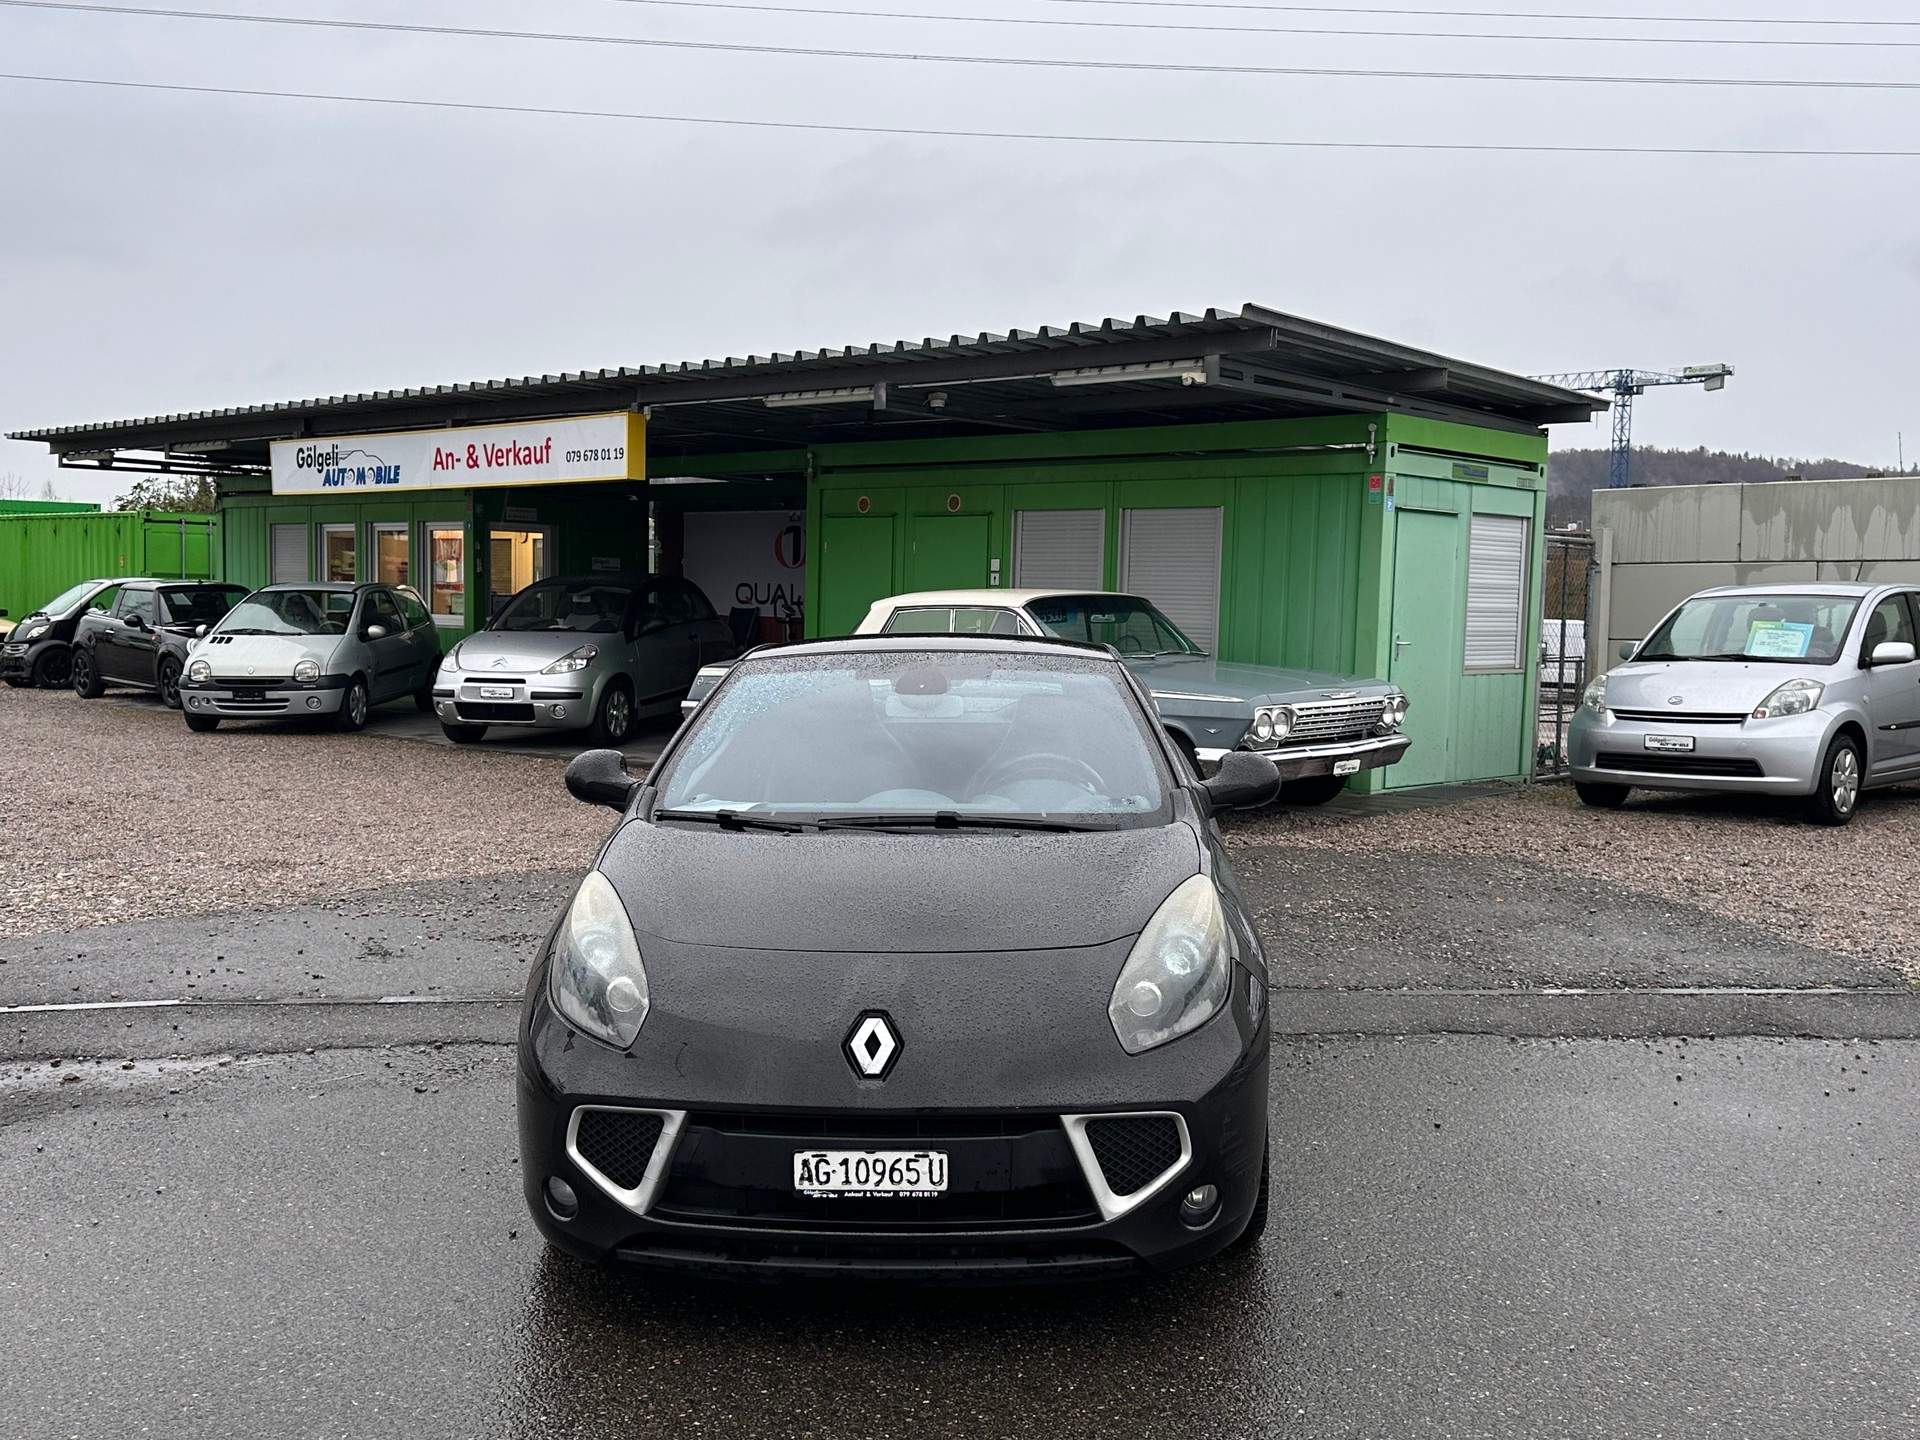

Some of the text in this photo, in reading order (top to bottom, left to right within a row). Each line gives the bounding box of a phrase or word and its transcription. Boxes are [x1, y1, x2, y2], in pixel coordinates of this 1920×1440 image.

[296, 444, 339, 473] Gölgeli
[433, 437, 552, 471] An- & Verkauf
[565, 446, 625, 463] 079 678 01 19
